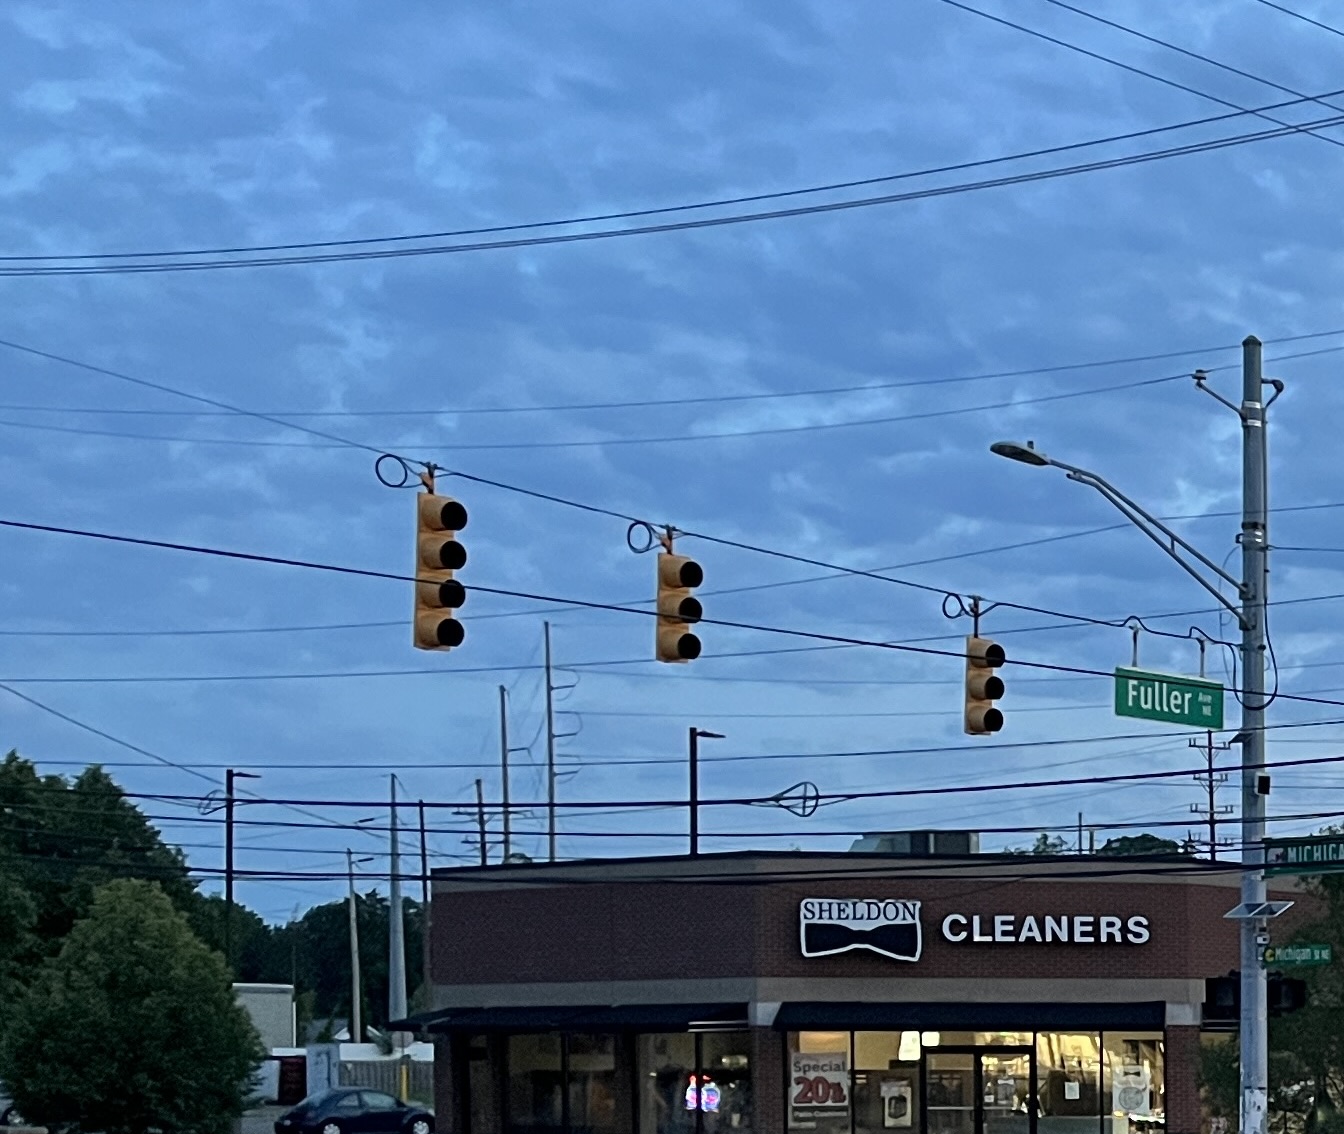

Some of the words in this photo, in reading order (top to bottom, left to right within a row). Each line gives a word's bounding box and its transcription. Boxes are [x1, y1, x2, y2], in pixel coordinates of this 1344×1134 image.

[1127, 679, 1193, 715] Fuller
[803, 901, 917, 921] SHELDON
[942, 914, 1150, 944] CLEANERS
[793, 1060, 847, 1075] Special
